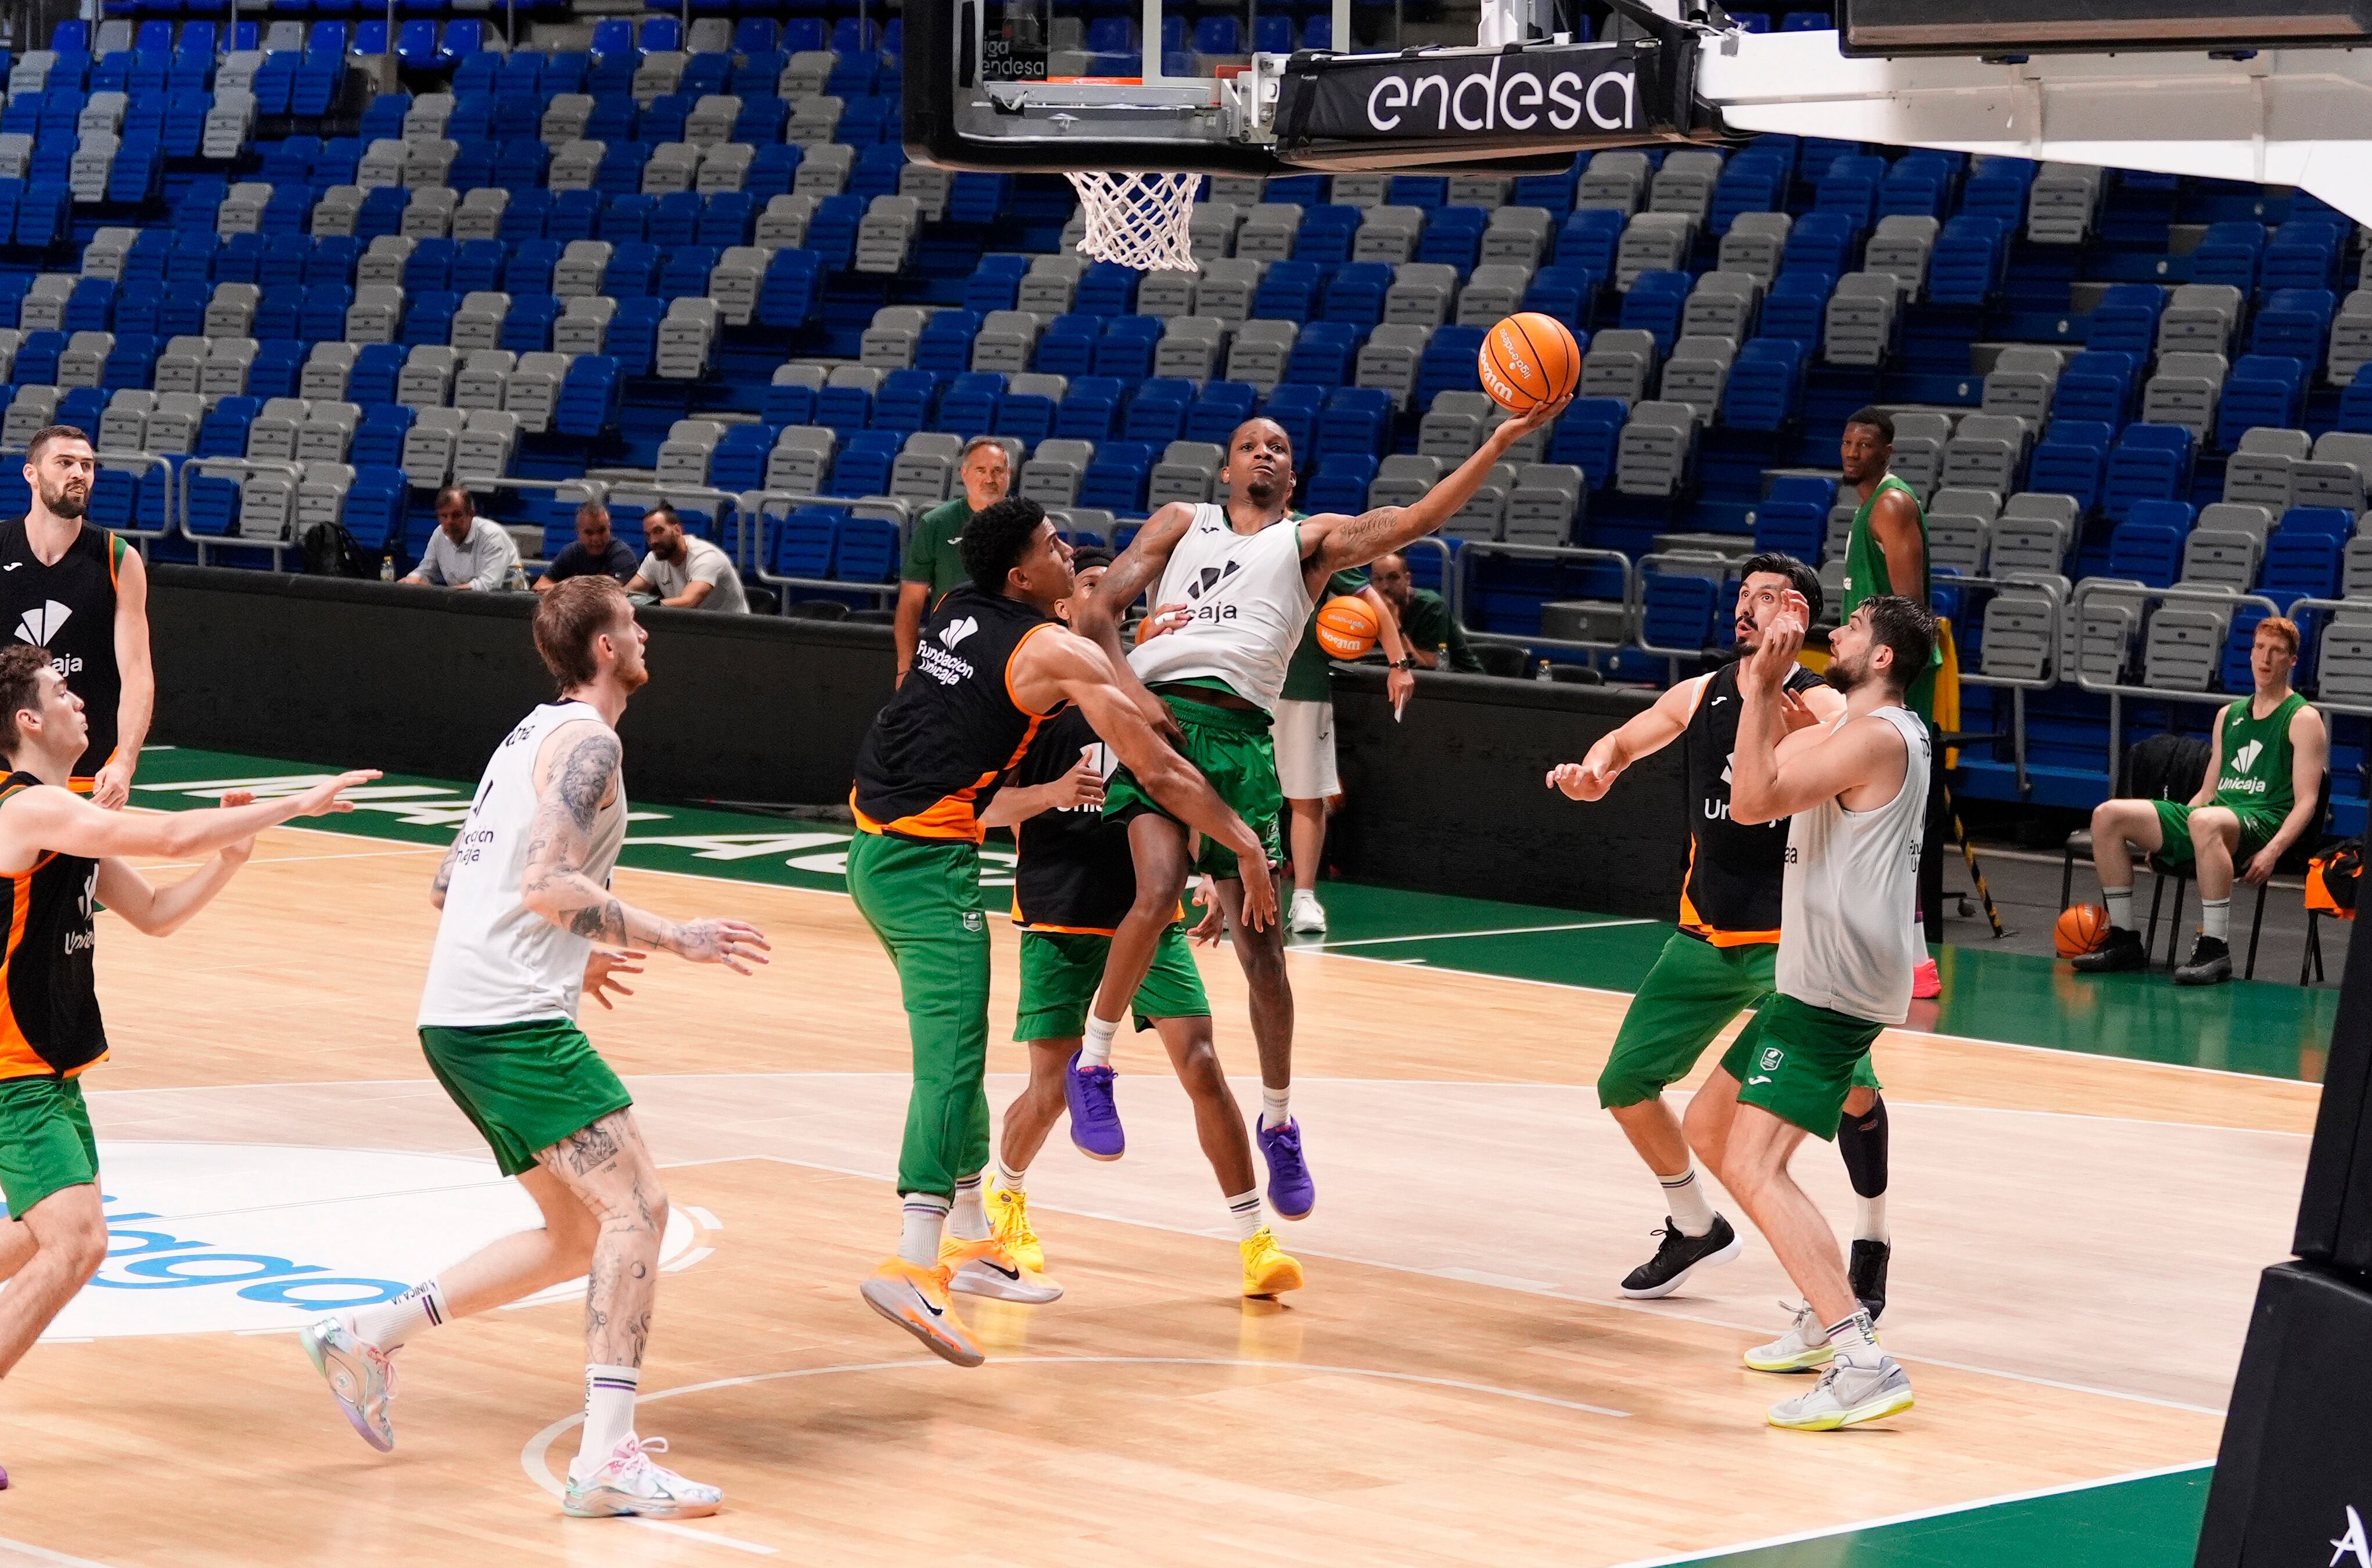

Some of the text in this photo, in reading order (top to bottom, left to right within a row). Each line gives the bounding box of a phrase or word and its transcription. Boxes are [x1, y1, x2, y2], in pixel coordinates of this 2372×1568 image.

[983, 56, 1044, 75] endesa
[1367, 56, 1636, 131] endesa
[1498, 328, 1519, 361] endesa
[916, 639, 974, 679] Fundación
[918, 657, 960, 686] Unicaja
[2218, 776, 2266, 794] Unicaja
